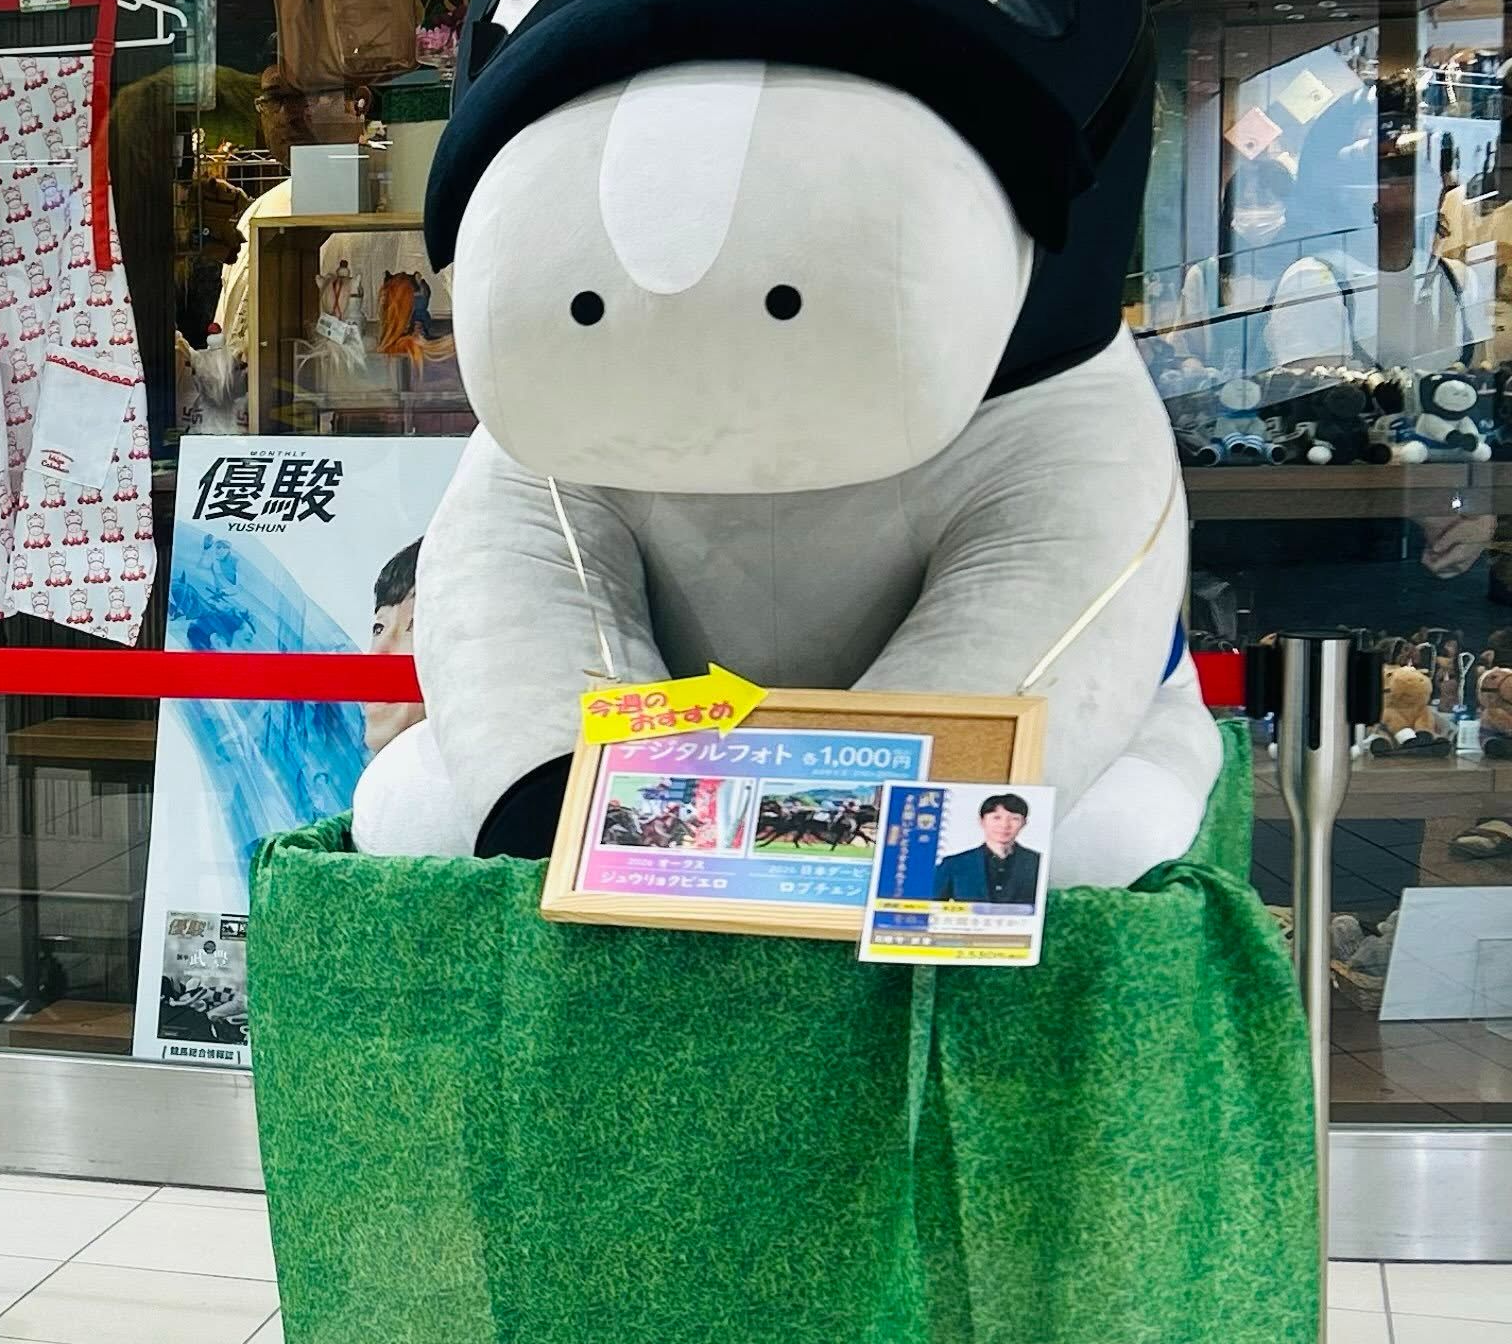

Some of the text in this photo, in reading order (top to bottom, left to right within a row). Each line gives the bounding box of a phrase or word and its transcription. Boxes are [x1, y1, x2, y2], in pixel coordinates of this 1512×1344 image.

[192, 457, 344, 523] 優駿
[227, 522, 287, 533] YUSHUN
[588, 691, 667, 717] 今週の
[630, 700, 735, 733] おすすめ
